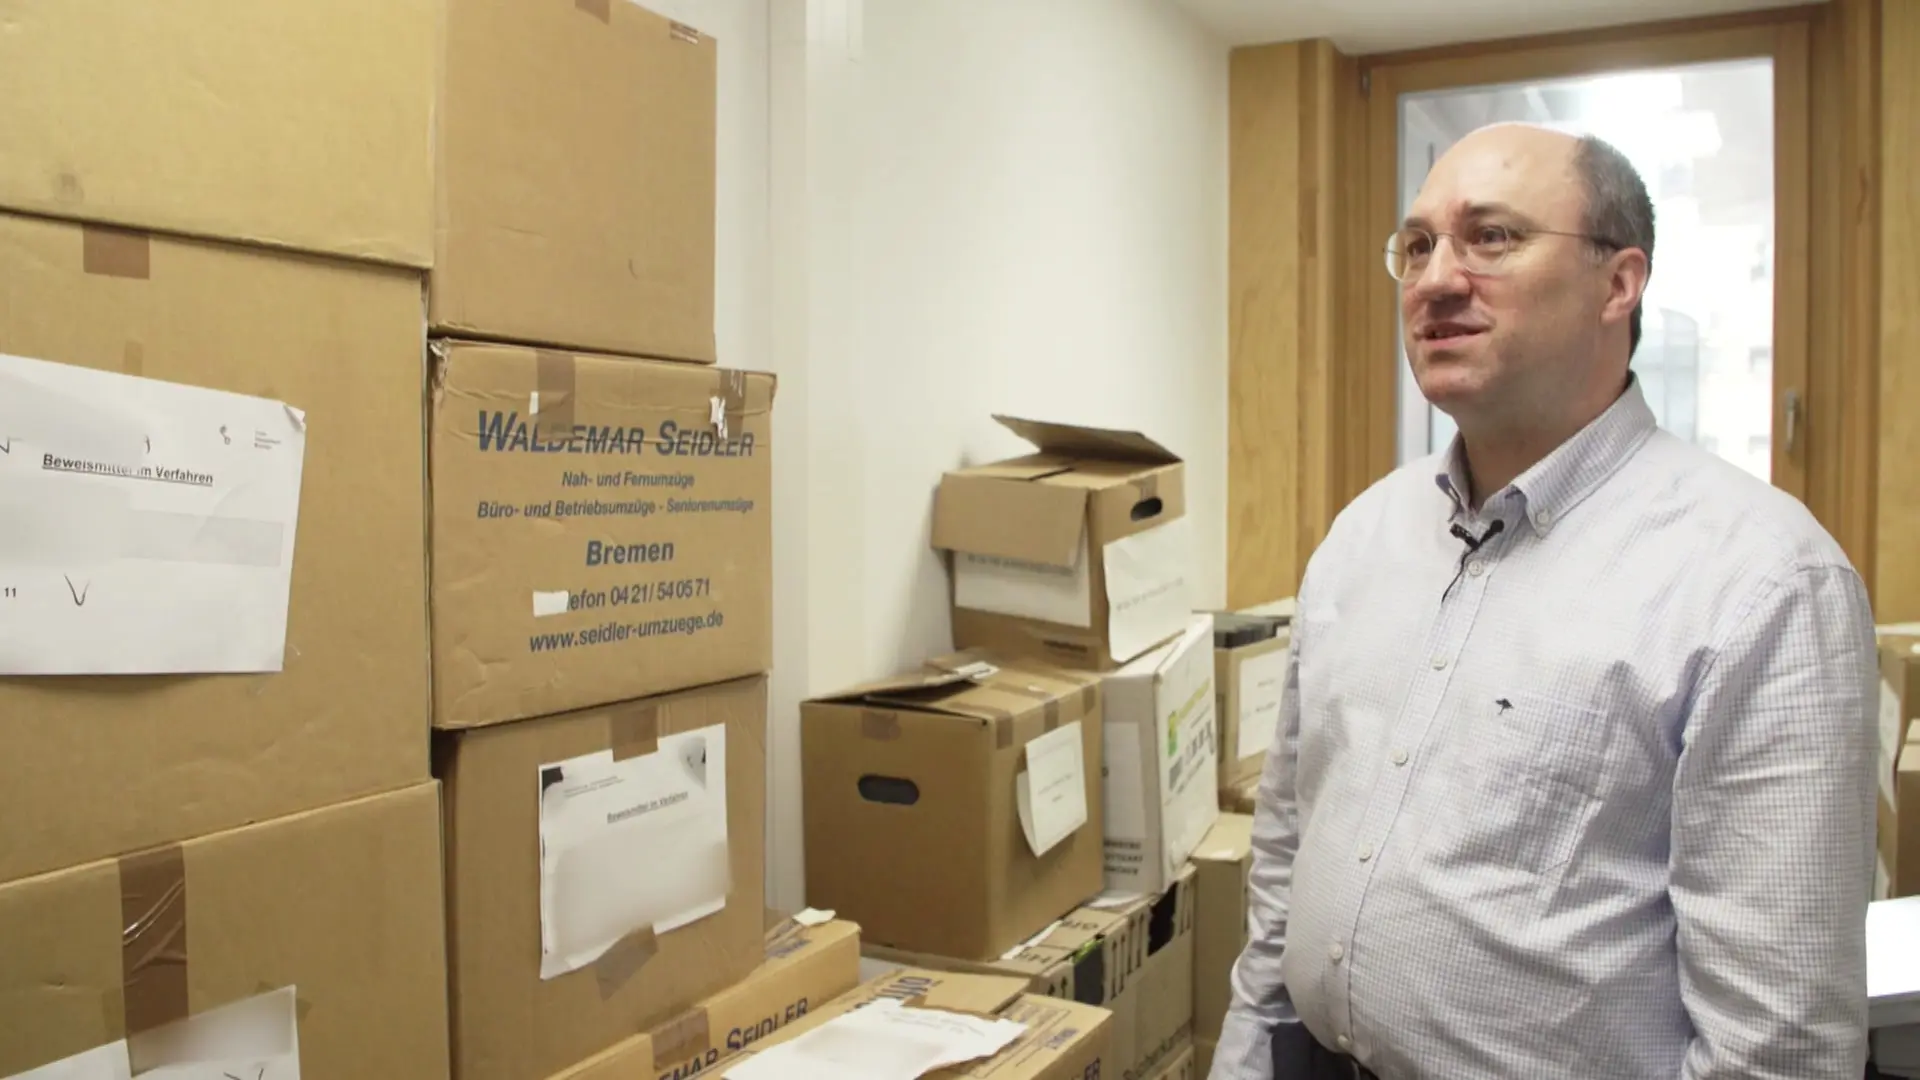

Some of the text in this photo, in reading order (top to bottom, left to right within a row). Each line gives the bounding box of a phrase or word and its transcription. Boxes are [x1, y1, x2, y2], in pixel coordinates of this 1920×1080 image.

[479, 410, 754, 456] WALDEMAR SEIDLER
[156, 467, 213, 485] Verfahren
[562, 471, 593, 487] Nah-
[596, 471, 622, 487] und
[477, 500, 519, 519] Büro-
[524, 501, 551, 518] und
[555, 499, 656, 517] Betriebsumzüge
[667, 497, 754, 513] Seniorenumzüge
[586, 540, 674, 566] Bremen
[566, 588, 606, 610] lefon
[530, 610, 724, 653] www.seidler-umzuege.de
